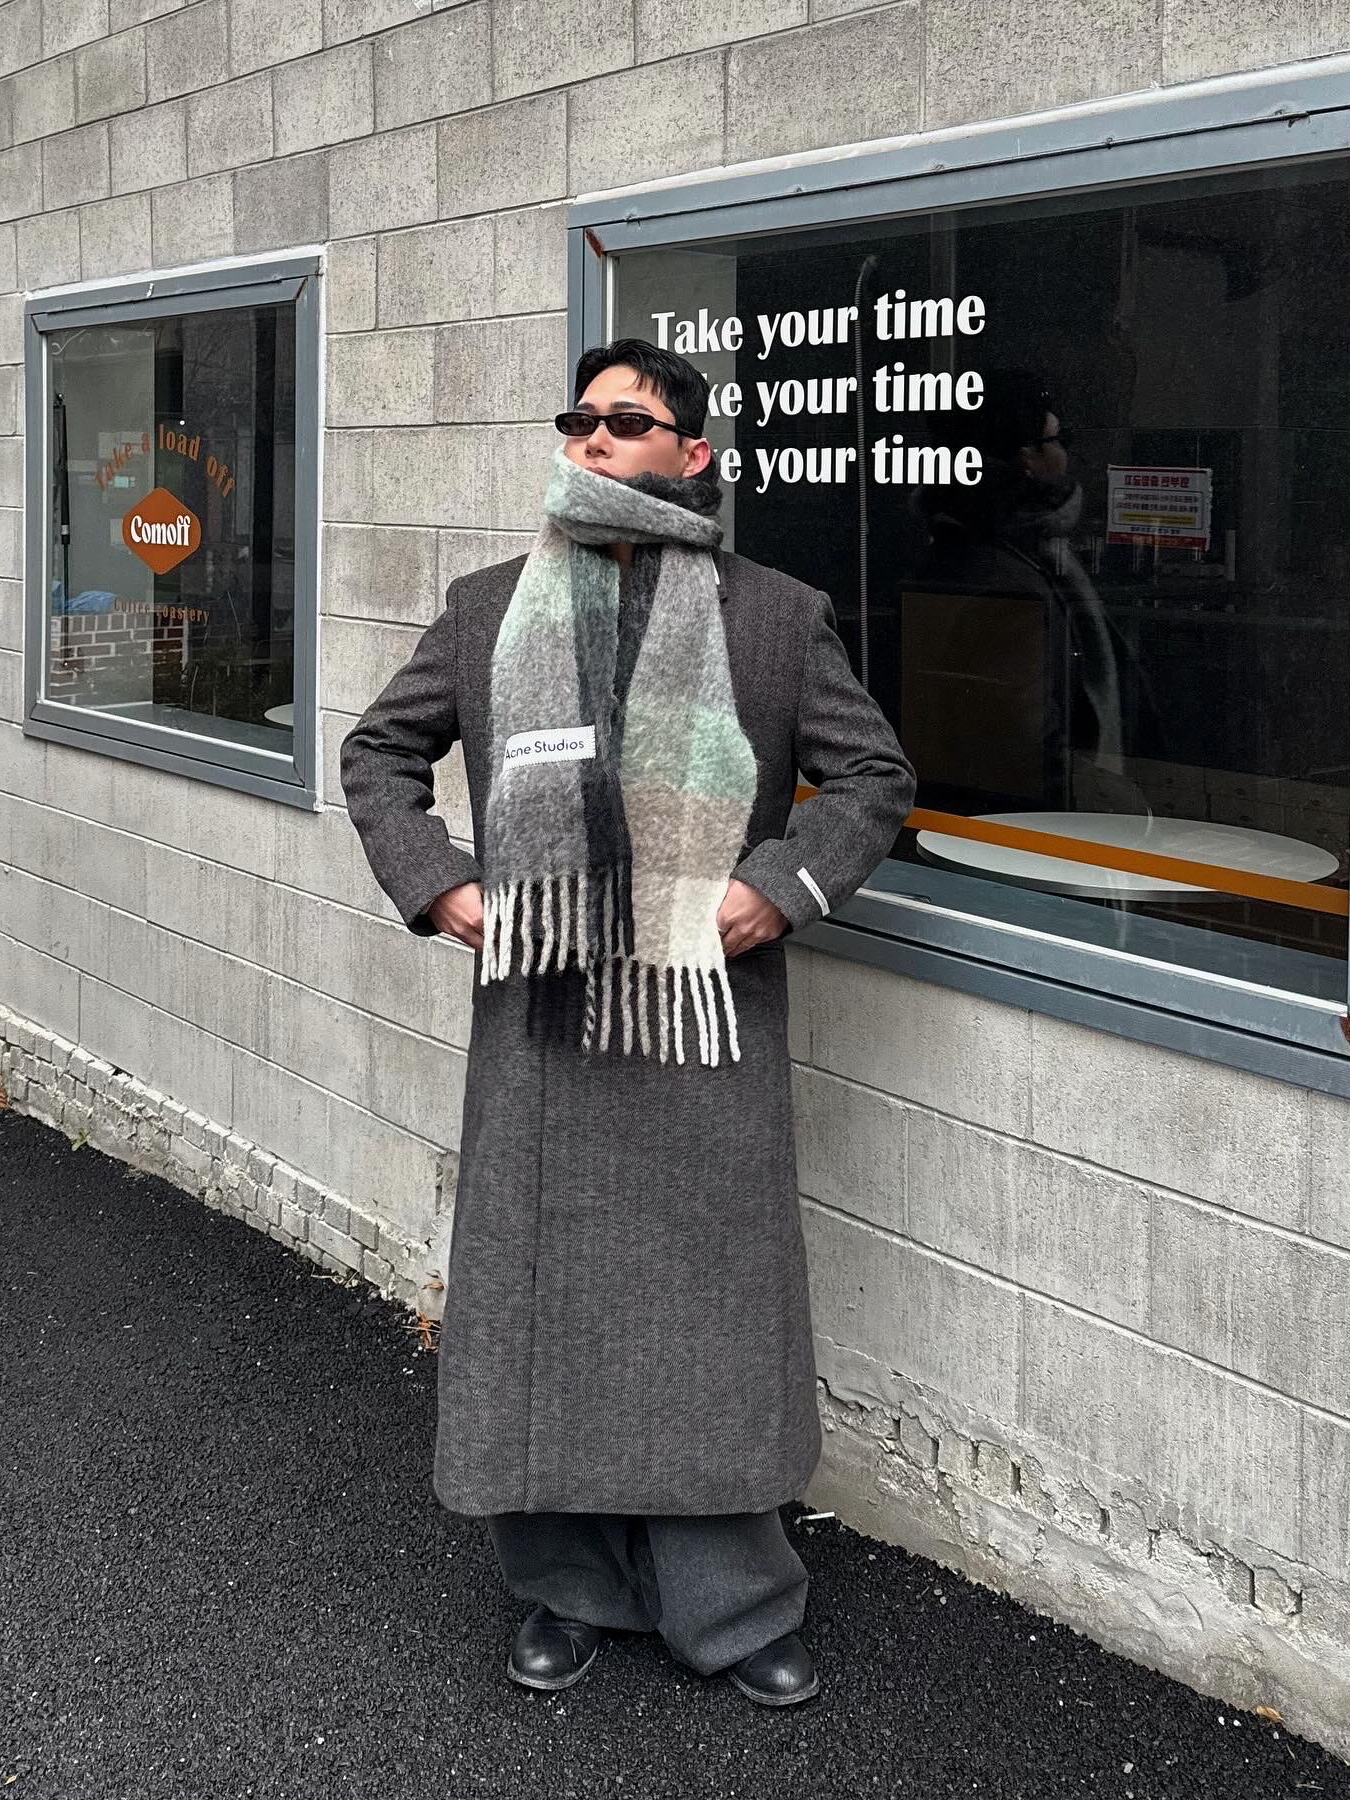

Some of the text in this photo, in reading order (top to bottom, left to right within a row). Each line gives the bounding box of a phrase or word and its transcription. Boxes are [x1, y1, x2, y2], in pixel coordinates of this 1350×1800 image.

[651, 289, 986, 360] Take your time
[701, 361, 984, 427] ke your time
[158, 424, 201, 461] load
[206, 455, 236, 498] off
[755, 447, 857, 494] your
[871, 434, 983, 486] time
[130, 515, 191, 546] Comoff
[505, 739, 585, 760] Acne Studios
